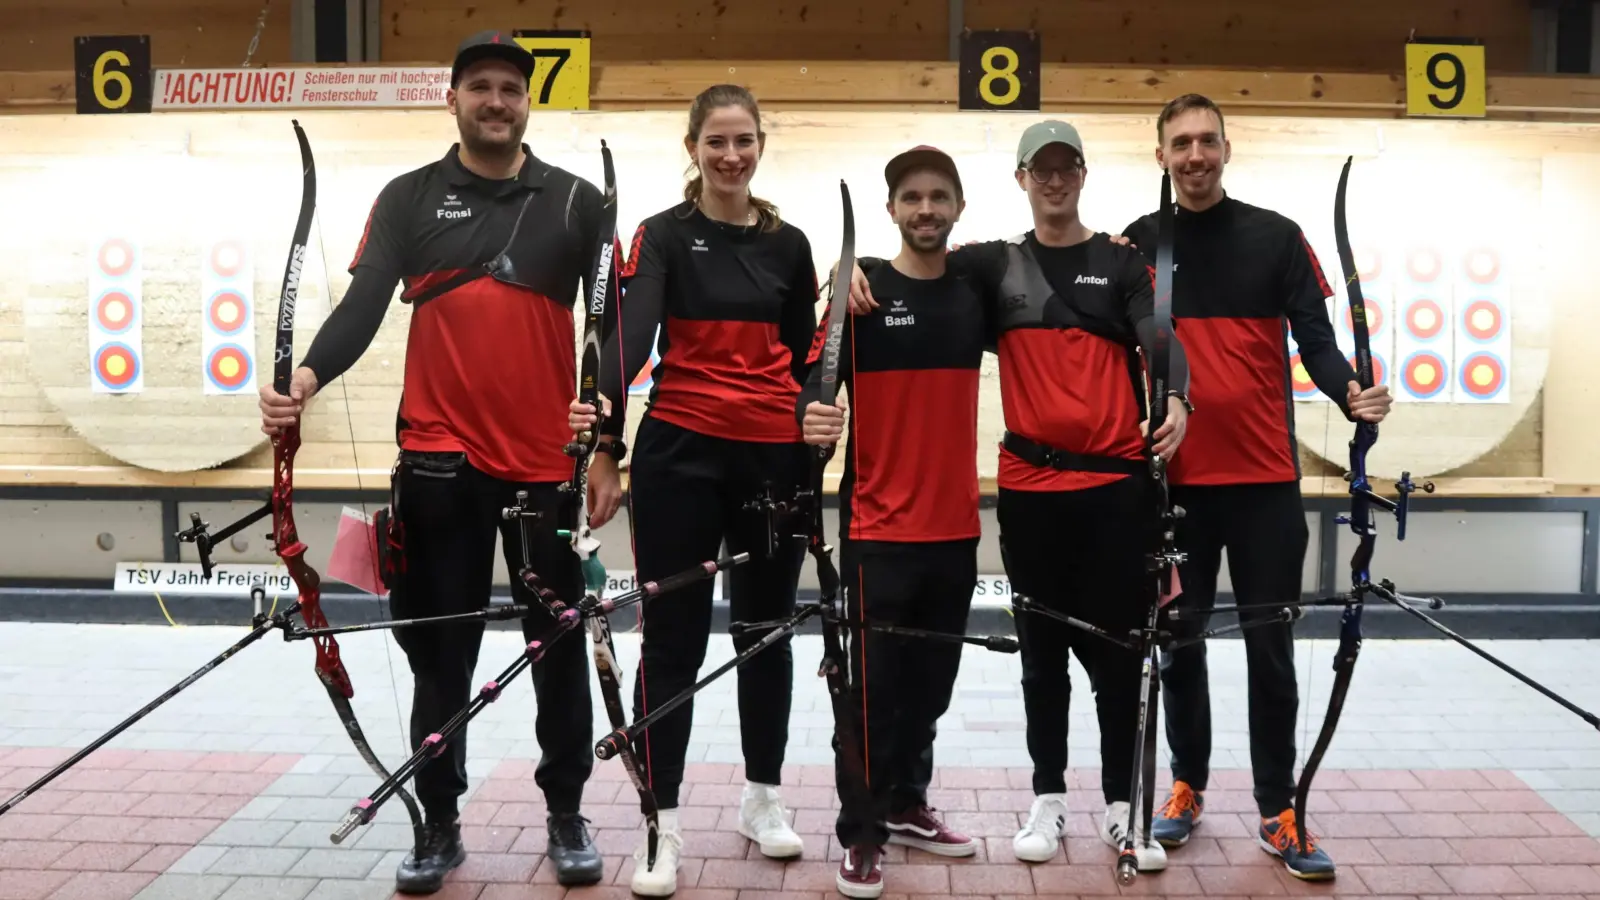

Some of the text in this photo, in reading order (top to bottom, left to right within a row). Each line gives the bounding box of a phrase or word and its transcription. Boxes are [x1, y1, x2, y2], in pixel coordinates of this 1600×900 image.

[92, 50, 133, 109] 6
[163, 71, 295, 104] !ACHTUNG!
[304, 71, 355, 84] Schießen
[358, 74, 376, 84] nur
[380, 70, 398, 84] mit
[531, 48, 571, 104] 7
[978, 46, 1021, 105] 8
[1426, 52, 1466, 109] 9
[302, 88, 378, 102] Fensterschutz
[436, 207, 472, 219] Fonsi
[281, 244, 307, 331] WIAWIS
[592, 242, 614, 315] WIAWIS
[1074, 274, 1109, 286] Anton
[884, 314, 916, 327] Basti
[126, 569, 291, 591] TSV Jahn Freising
